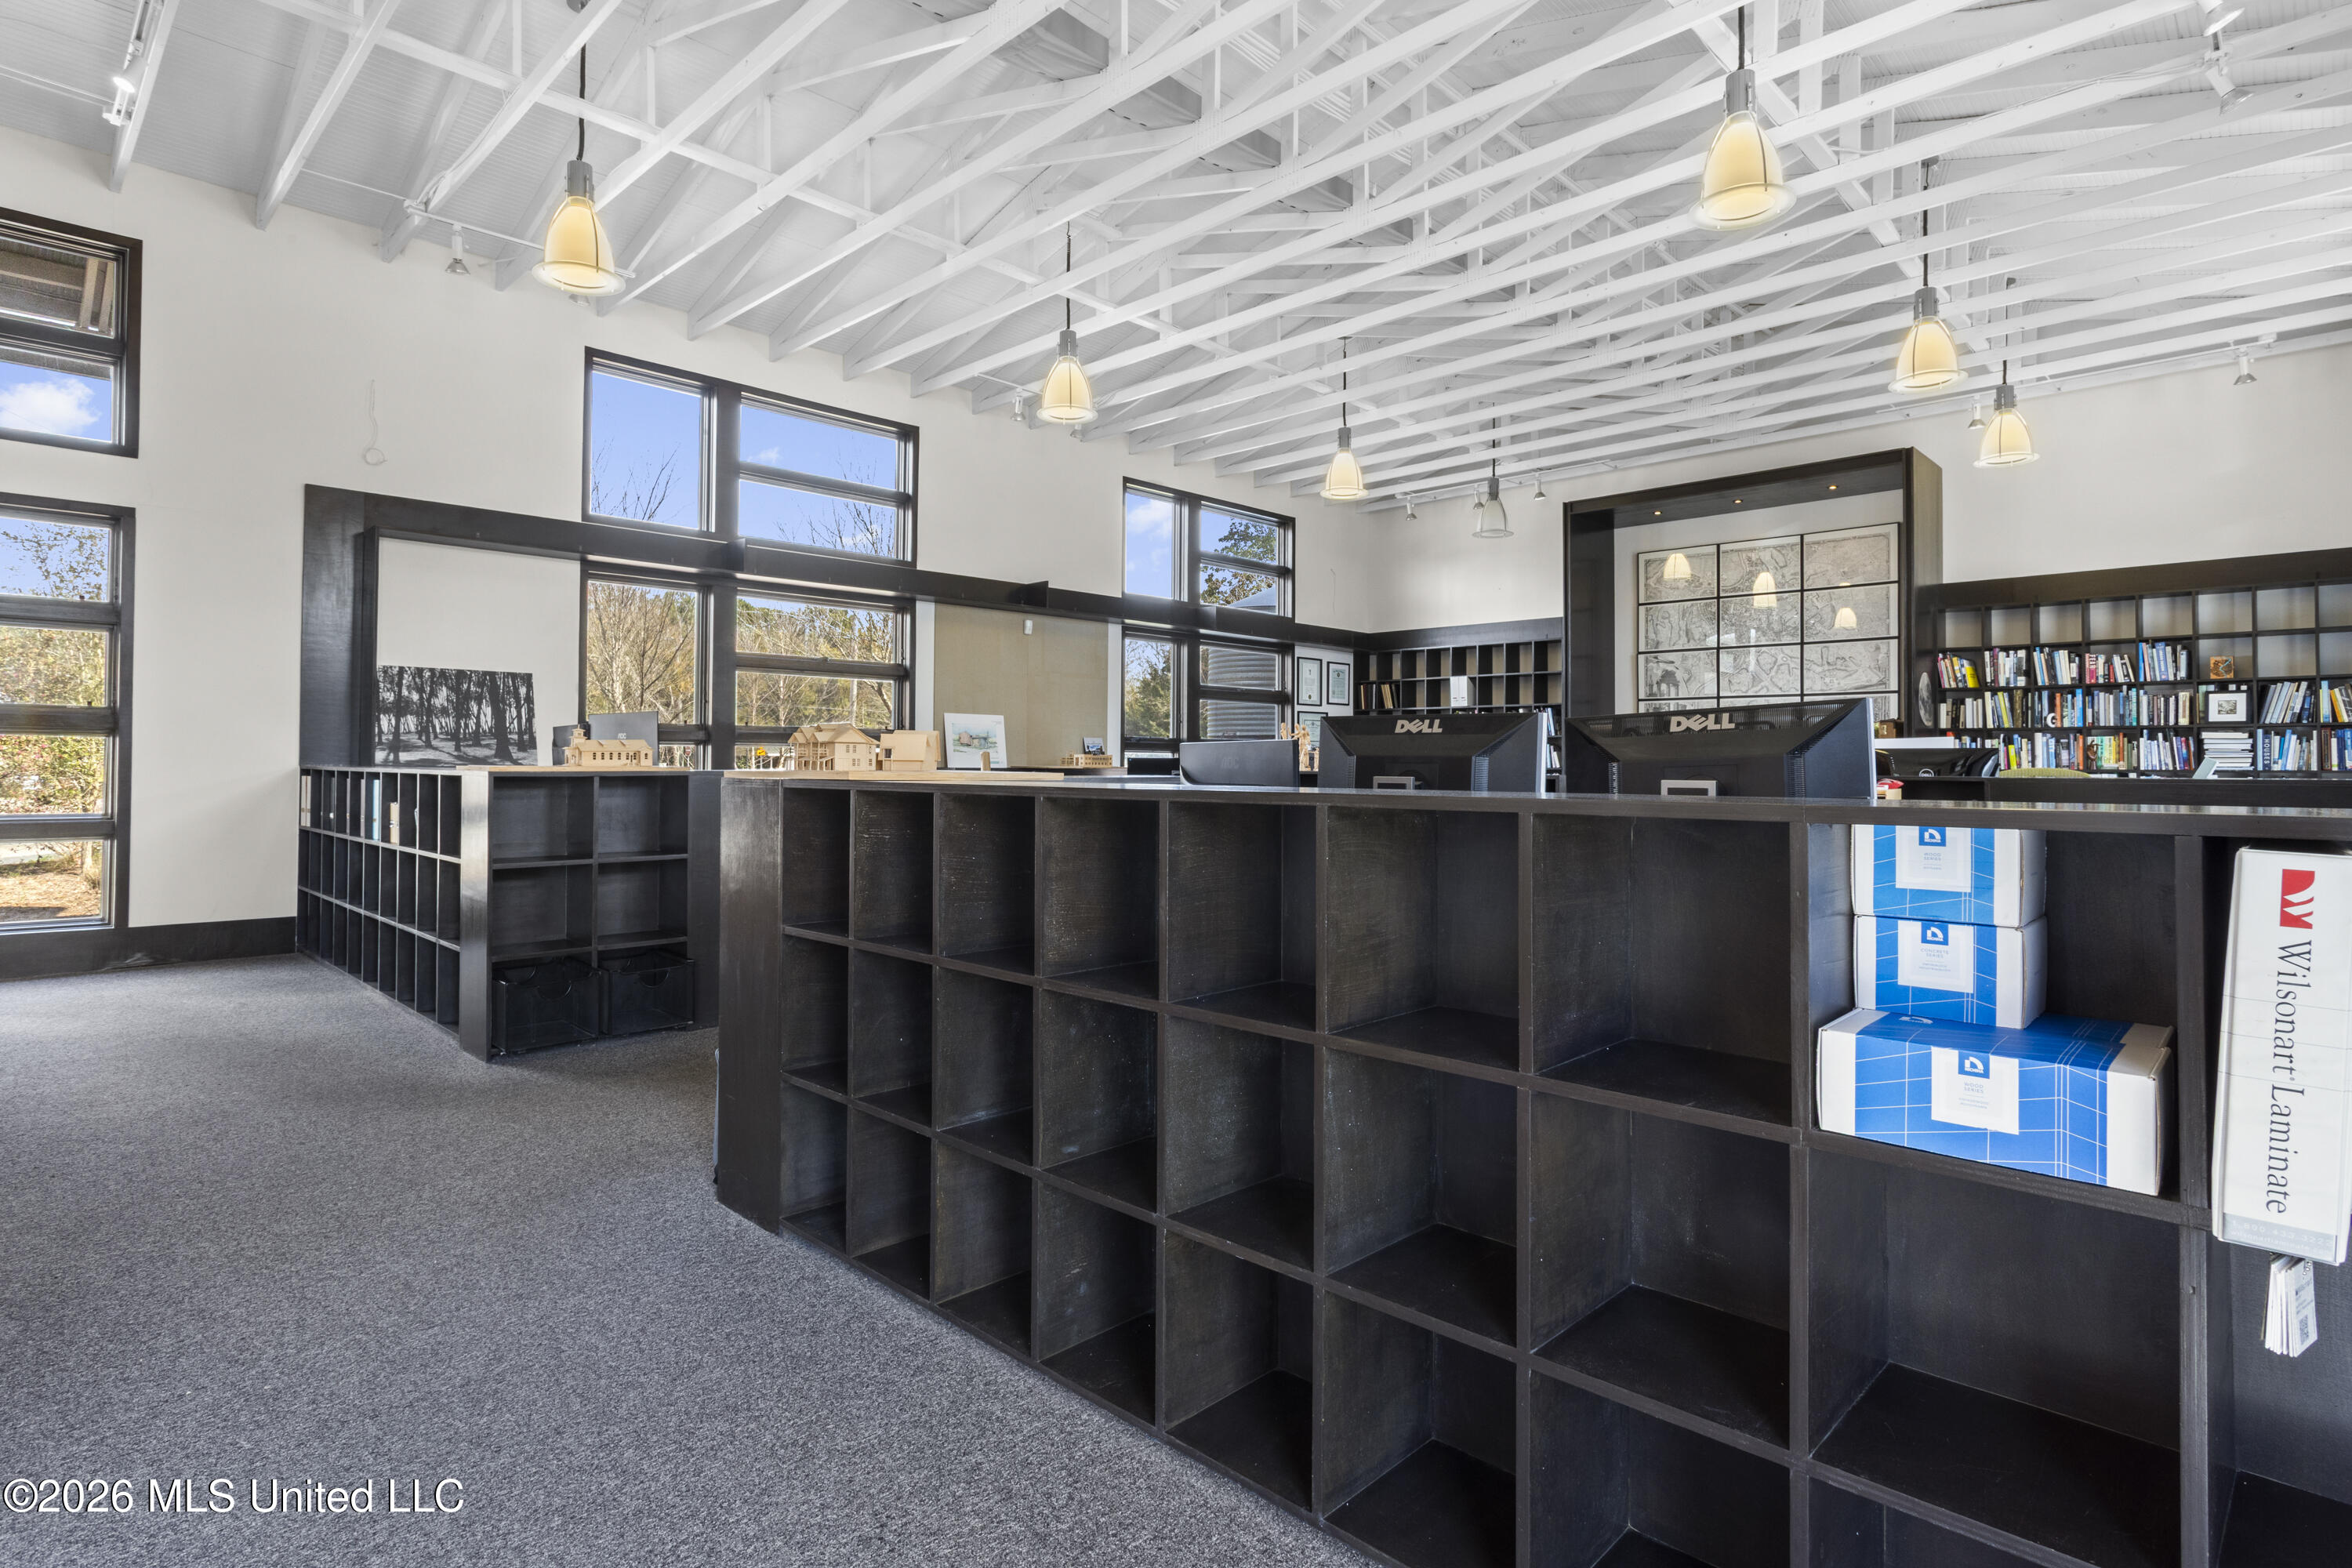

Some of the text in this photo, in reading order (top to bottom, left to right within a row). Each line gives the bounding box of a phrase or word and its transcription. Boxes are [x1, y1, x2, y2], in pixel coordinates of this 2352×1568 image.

[1394, 718, 1443, 734] DELL
[1669, 713, 1735, 732] DELL
[2266, 1083, 2304, 1214] Laminate
